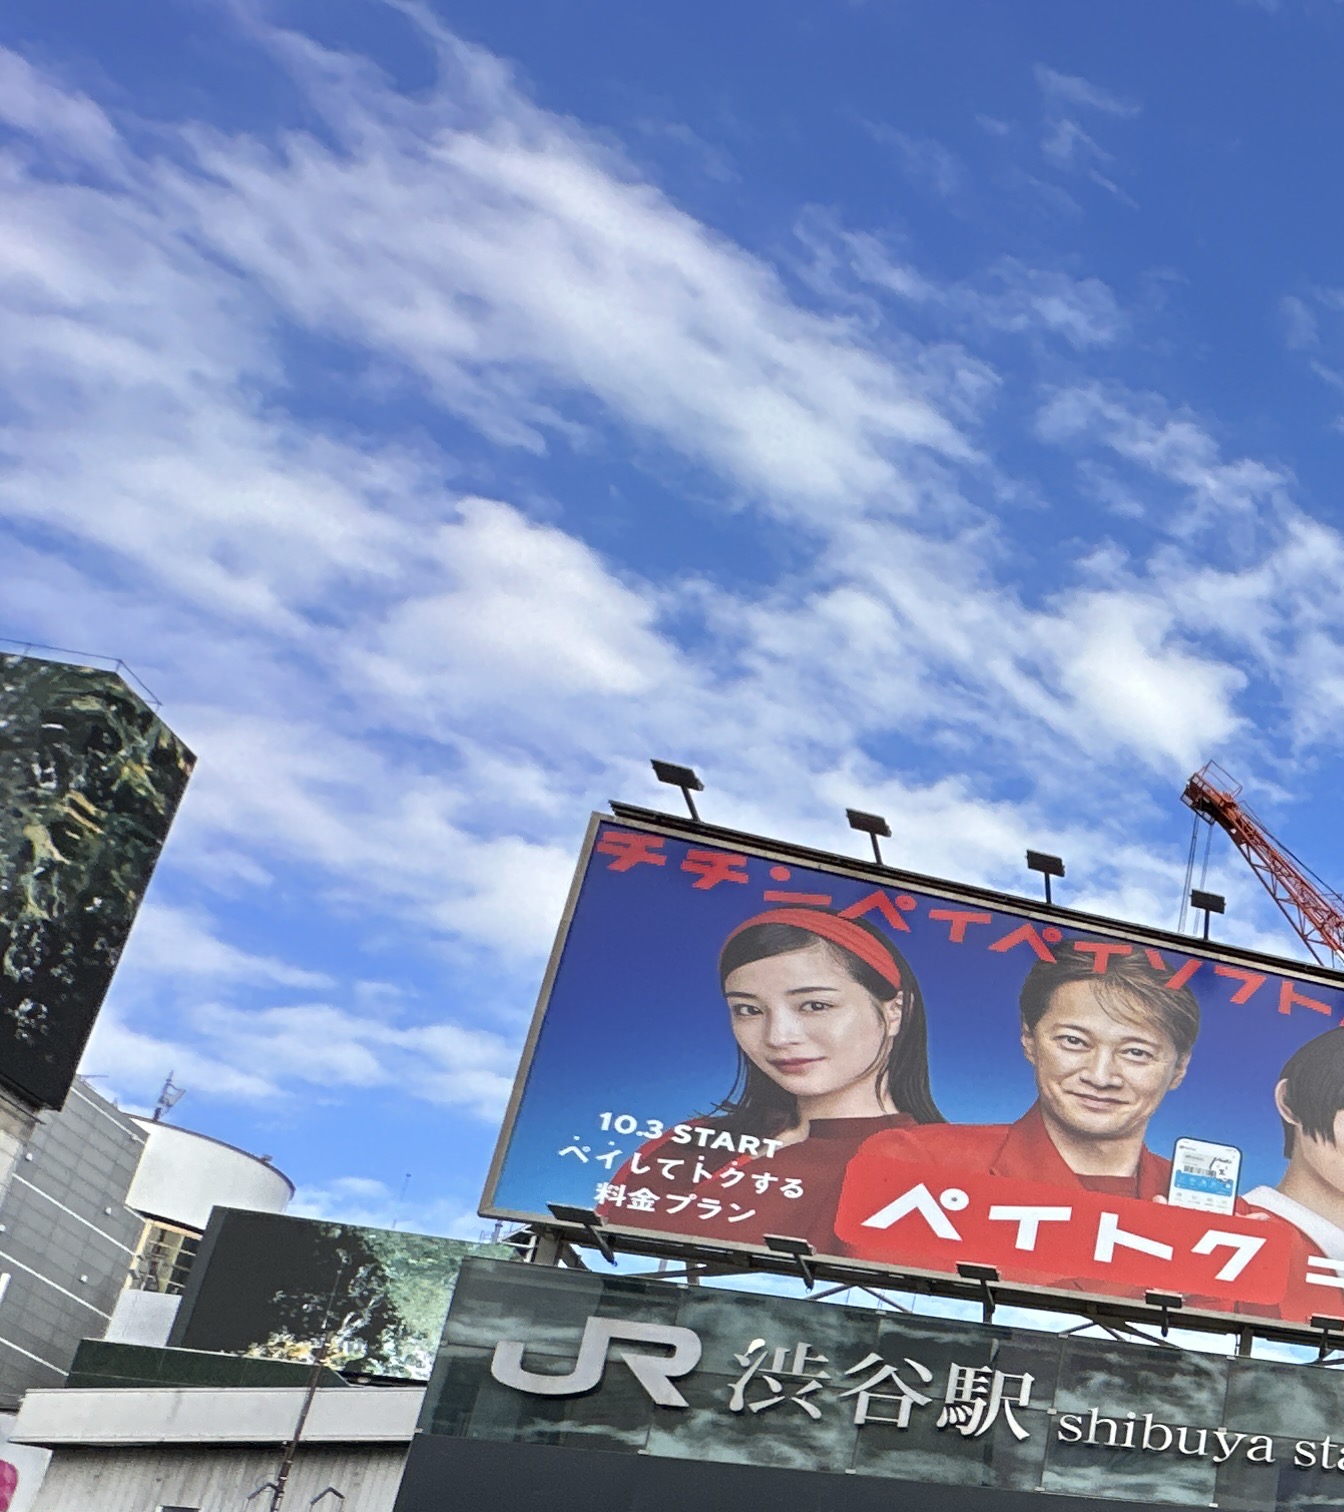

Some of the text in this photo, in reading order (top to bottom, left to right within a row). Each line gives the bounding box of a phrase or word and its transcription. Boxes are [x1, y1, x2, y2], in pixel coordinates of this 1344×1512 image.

[600, 1112, 783, 1158] 10.3 START
[558, 1136, 805, 1200] ペイしてトクする
[593, 1182, 756, 1222] 料金プラン
[862, 1182, 1267, 1283] ペイトク
[490, 1316, 702, 1408] JR
[727, 1338, 1035, 1441] 渋谷駅
[1057, 1408, 1276, 1467] shibuya
